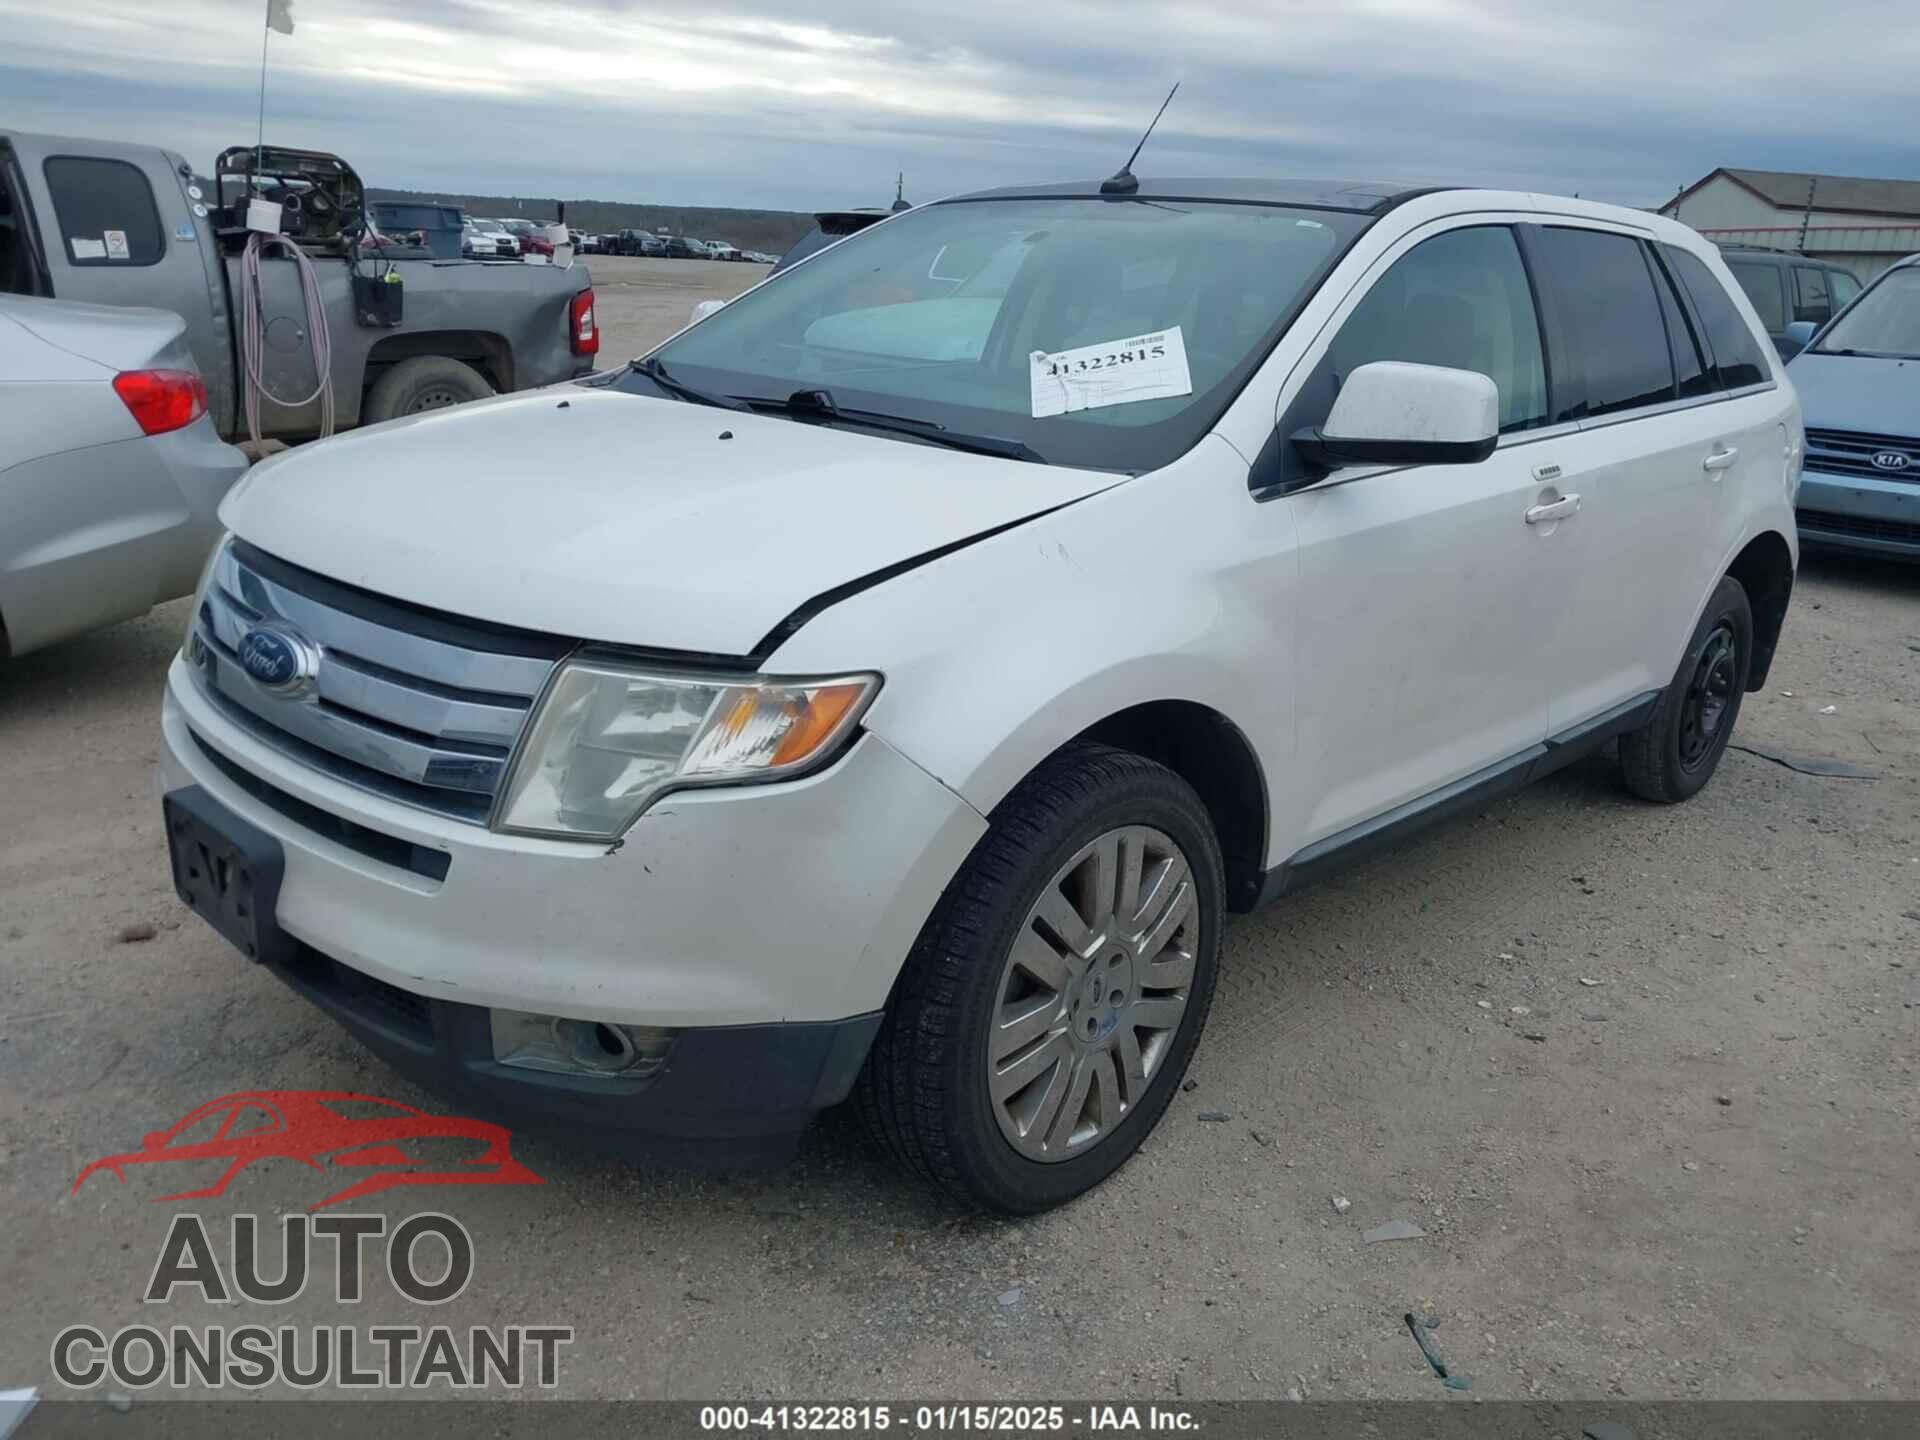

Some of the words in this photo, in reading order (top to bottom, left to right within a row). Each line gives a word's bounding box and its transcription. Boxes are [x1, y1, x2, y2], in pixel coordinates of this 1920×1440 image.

[1046, 345, 1165, 376] 41322815
[1877, 454, 1903, 466] KIA
[243, 634, 285, 676] Ford
